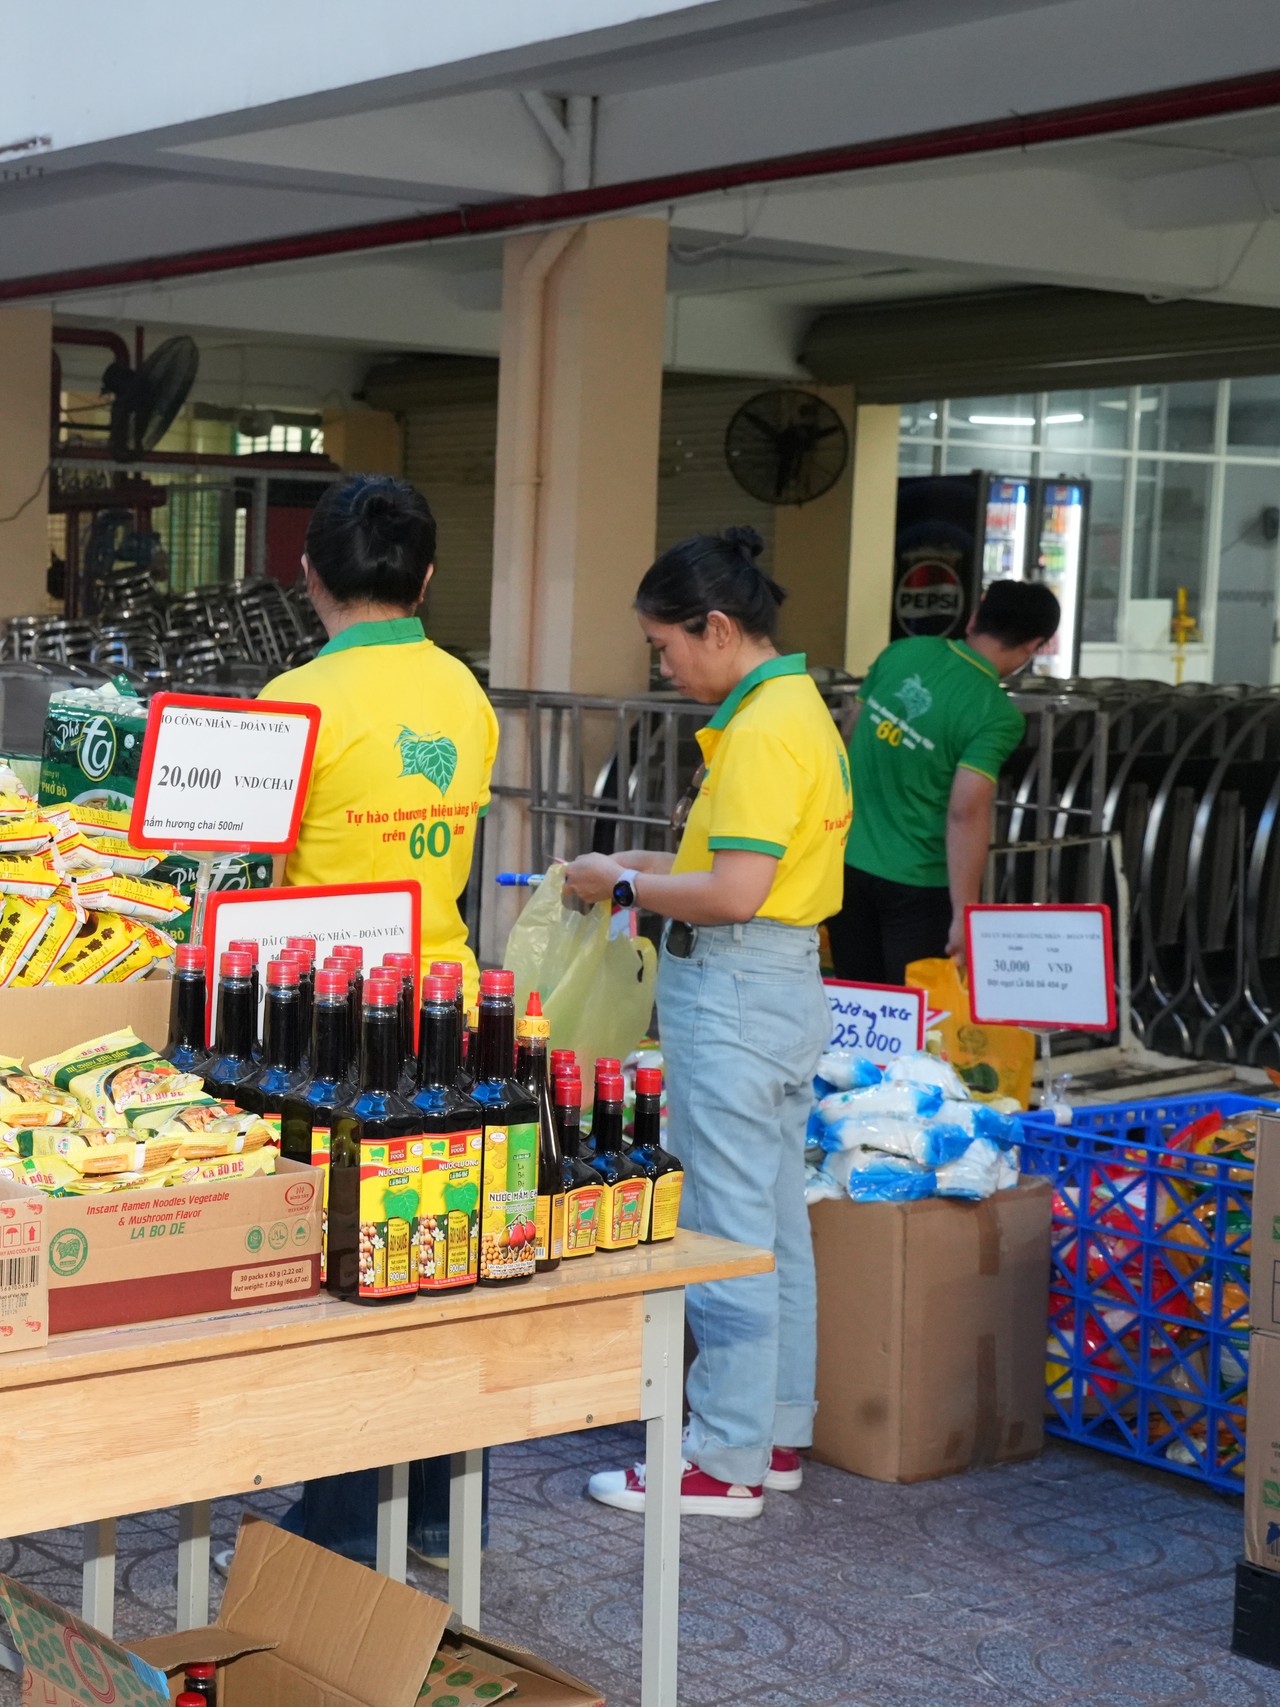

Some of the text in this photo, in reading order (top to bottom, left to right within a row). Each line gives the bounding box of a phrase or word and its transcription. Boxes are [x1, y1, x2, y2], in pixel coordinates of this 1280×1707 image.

[900, 591, 958, 609] PEPSI
[174, 713, 291, 733] CÔNG NHÂN ĐOÀN VIÊN
[876, 720, 902, 747] 60
[57, 716, 112, 777] Phở ta
[157, 765, 294, 792] 20,000 VND/CHAI
[56, 783, 67, 797] BÒ
[165, 818, 195, 832] hương
[198, 819, 216, 831] chai
[218, 820, 244, 831] 500ml
[346, 804, 453, 827] Tự hào thương hiệu
[382, 829, 406, 843] trên
[409, 820, 451, 860] 60
[327, 929, 351, 941] NHÂN
[359, 927, 383, 939] ĐOÀN
[384, 924, 406, 937] VIÊN
[993, 959, 1073, 974] 30,000 VND
[880, 1004, 912, 1021] 1KG
[830, 1022, 902, 1054] 25.000
[86, 1191, 230, 1216] Instant Ramen Noodles Vegetable
[118, 1208, 202, 1227] & Mushroom Flavor
[130, 1221, 186, 1240] LA BO DE
[16, 1247, 28, 1255] COOL
[28, 1245, 41, 1253] PLACE
[240, 1274, 248, 1282] 30
[248, 1272, 265, 1282] packs
[268, 1270, 277, 1278] 63
[281, 1268, 295, 1277] (2.22
[295, 1266, 304, 1275] oz)
[233, 1275, 310, 1293] Net weight: 1.89 kg (66.67 oz)
